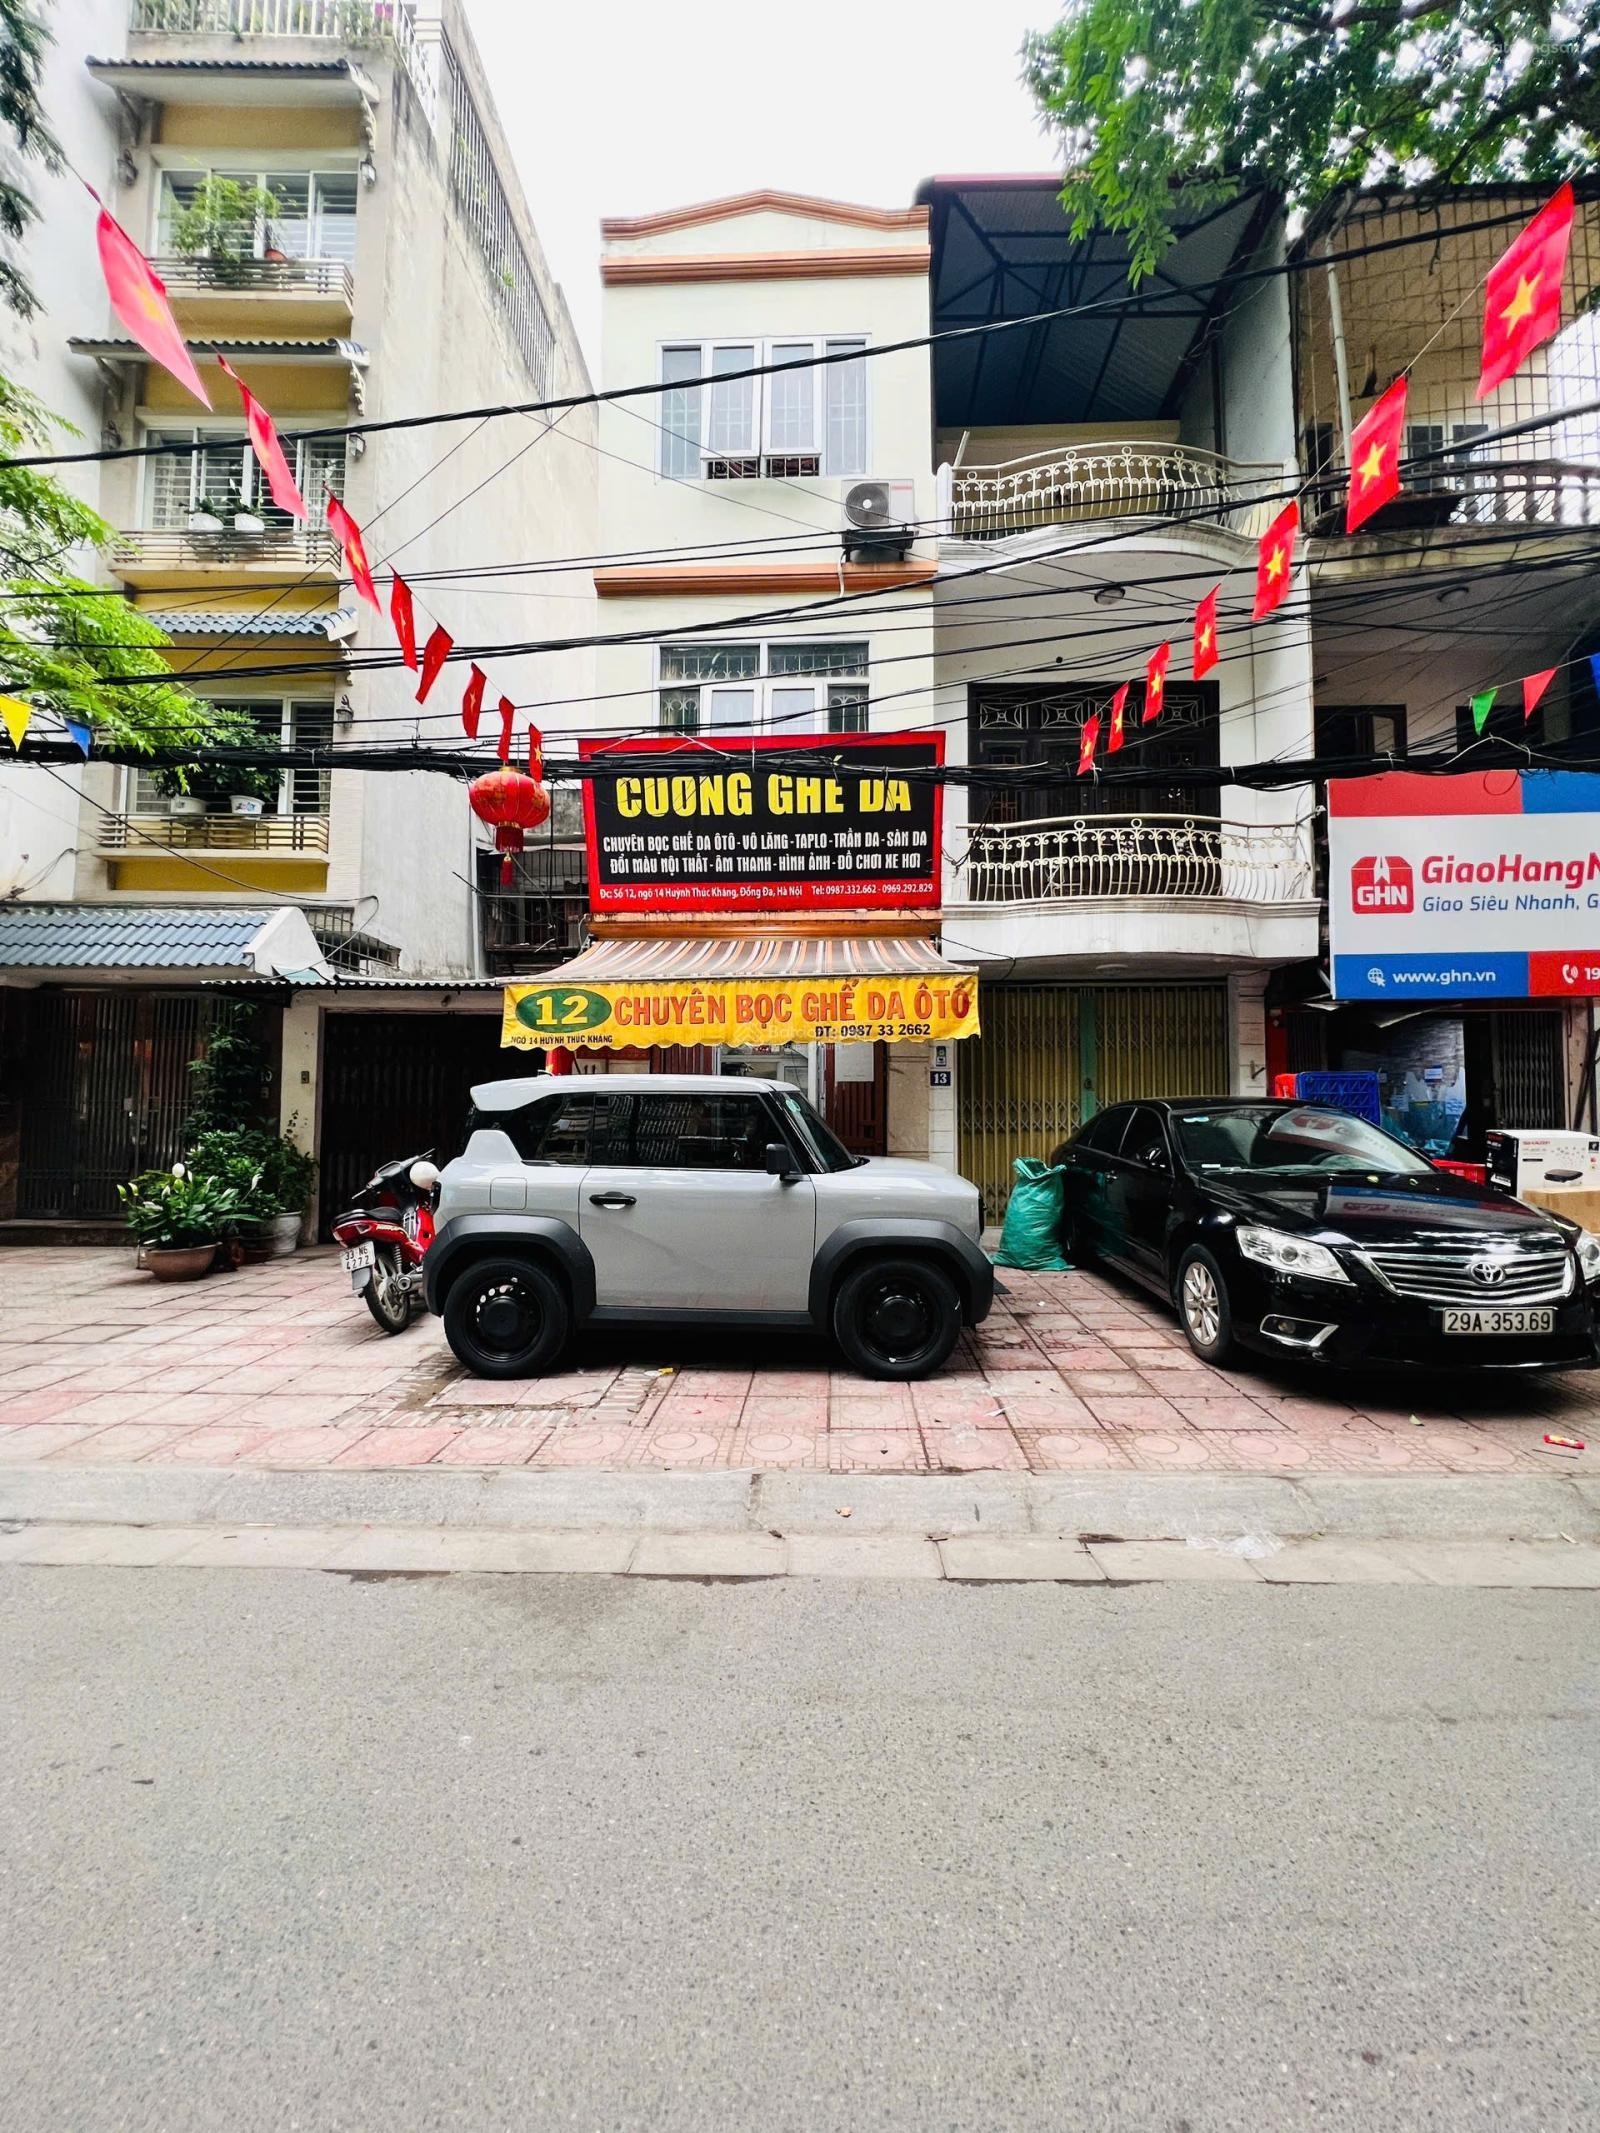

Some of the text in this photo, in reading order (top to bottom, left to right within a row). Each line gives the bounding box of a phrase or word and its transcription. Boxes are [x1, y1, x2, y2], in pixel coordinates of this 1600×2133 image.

[859, 779, 912, 812] DA
[603, 833, 645, 852] CHUYÊN
[648, 835, 669, 855] BỌC
[672, 830, 694, 851] GHẾ
[696, 835, 711, 850] DA
[912, 831, 927, 846] DA
[610, 853, 629, 874] ĐỔI
[632, 856, 657, 873] MÀU
[660, 855, 679, 876] NỘI
[856, 853, 882, 869] CHƠI
[884, 853, 898, 868] XE
[902, 853, 921, 868] HƠI
[655, 888, 664, 897] 14
[776, 886, 787, 896] Hà
[811, 885, 825, 895] Tel:
[1357, 885, 1408, 906] GHN
[1423, 897, 1463, 912] Giao
[1470, 895, 1508, 911] Siêu
[1515, 893, 1579, 911] Nhanh,
[1392, 969, 1496, 985] www.ghn.vn
[536, 995, 589, 1025] 12
[614, 987, 726, 1025] CHUYÊN
[736, 993, 792, 1029] BỌC
[801, 979, 859, 1022] GHẾ
[867, 991, 905, 1020] DA
[529, 1036, 538, 1044] 14
[815, 1023, 931, 1037] ĐT: 0987 33 2662
[934, 1072, 948, 1084] 13
[1447, 1312, 1551, 1332] 29A-353.69
